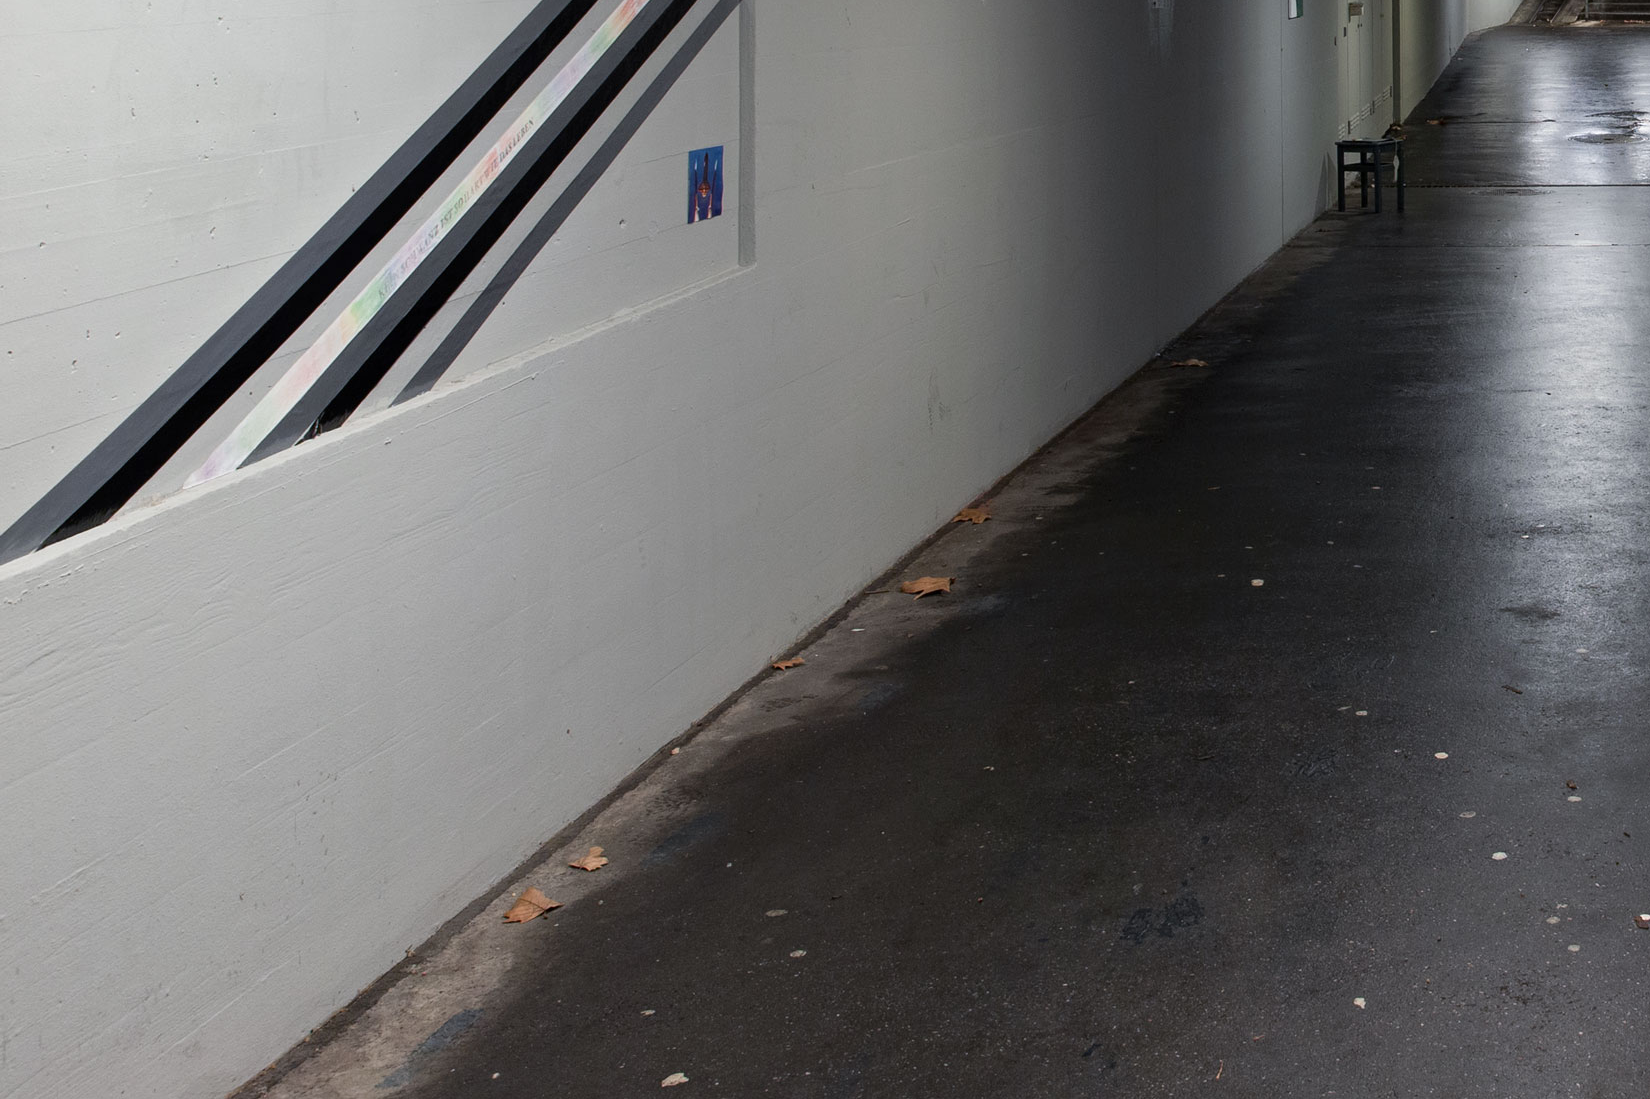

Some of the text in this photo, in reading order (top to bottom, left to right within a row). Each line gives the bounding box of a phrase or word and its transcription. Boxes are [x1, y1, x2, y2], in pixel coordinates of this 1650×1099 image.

[440, 207, 454, 229] IST
[499, 142, 513, 162] DAS
[512, 118, 535, 147] LEBEN
